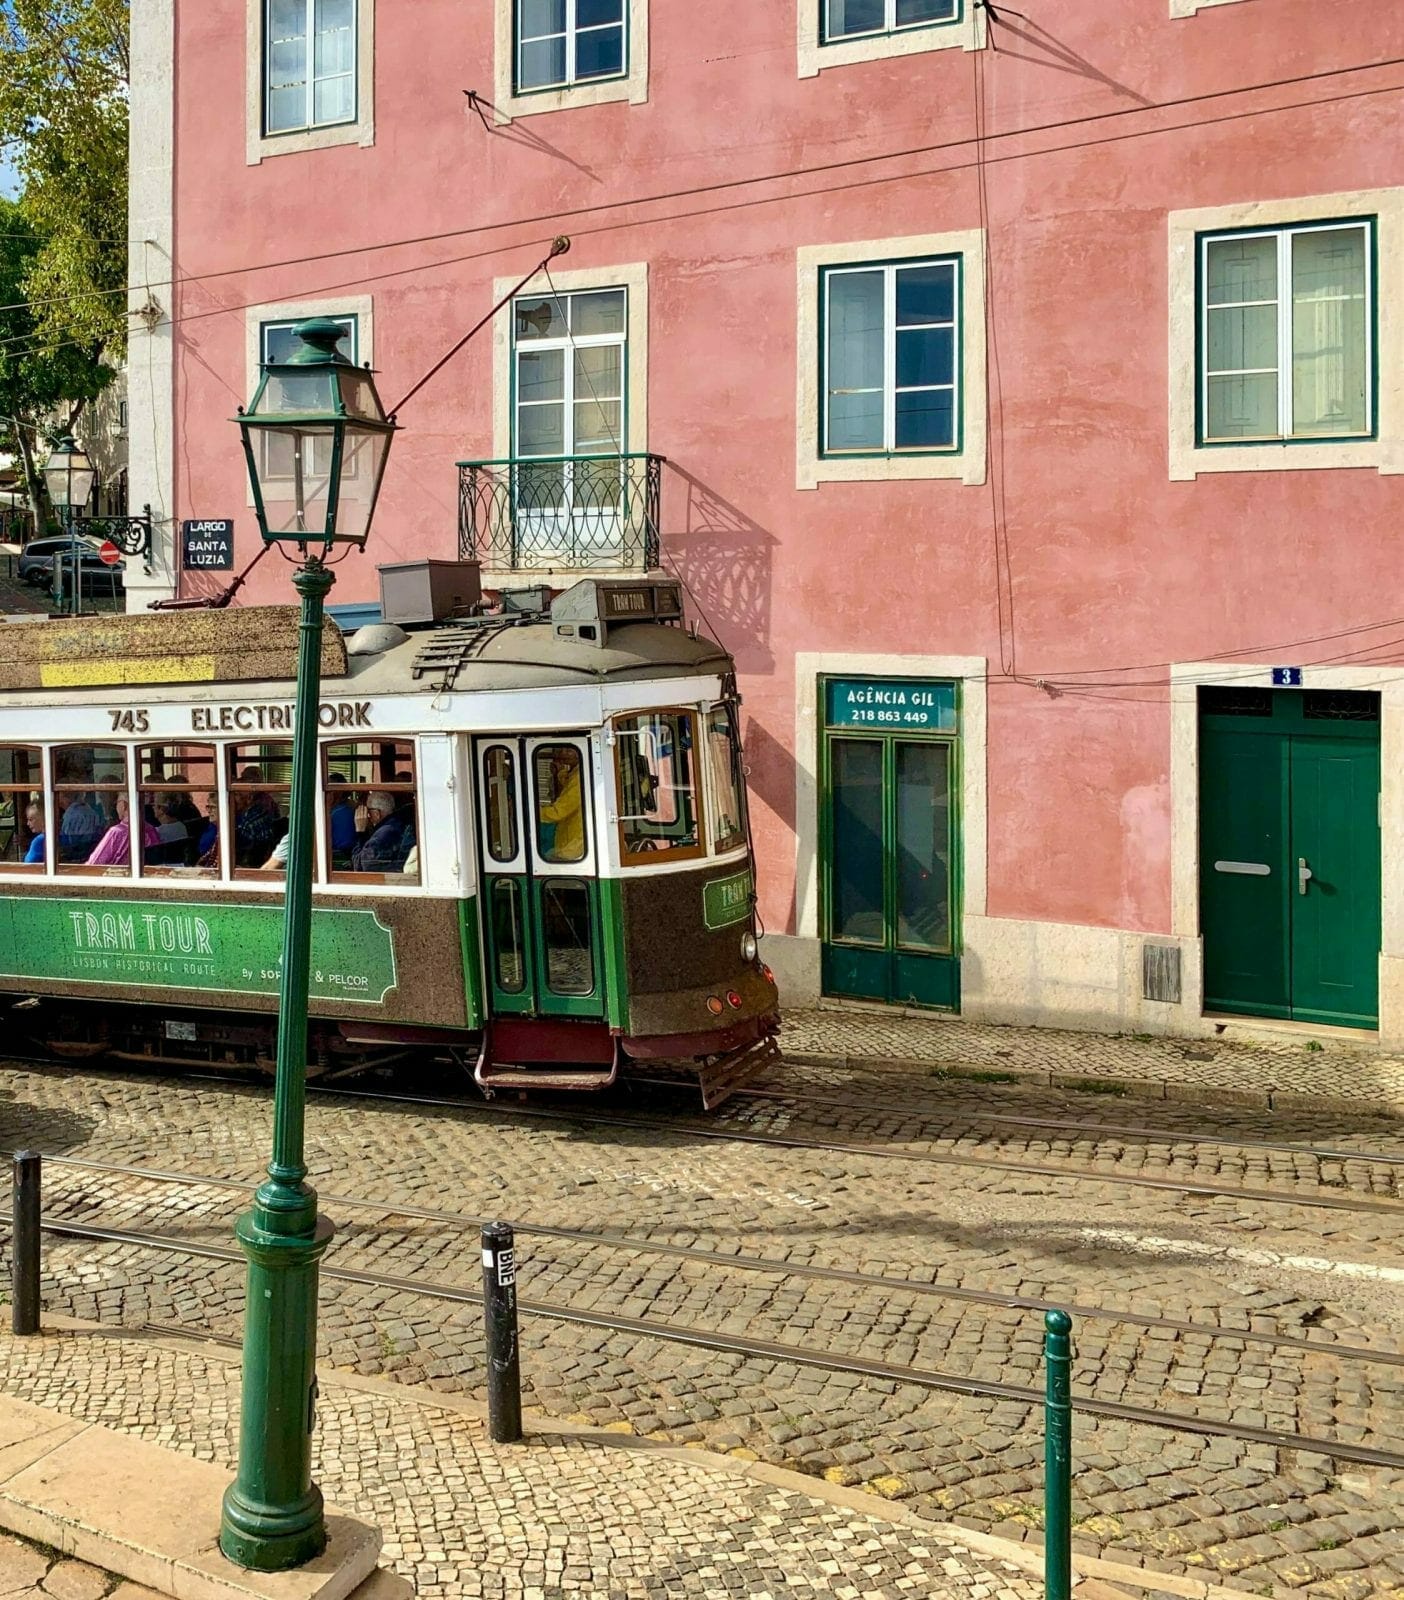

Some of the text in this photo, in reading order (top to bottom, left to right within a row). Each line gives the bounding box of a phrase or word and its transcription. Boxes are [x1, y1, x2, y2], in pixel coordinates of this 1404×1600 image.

[190, 521, 226, 531] LARGO
[188, 541, 227, 551] SANTA
[190, 554, 225, 565] LUZIA
[1282, 669, 1291, 684] 3
[847, 686, 935, 706] AGÊNCIA GIL
[108, 709, 149, 732] 745
[851, 709, 928, 723] 218 863 449
[69, 911, 213, 954] TRAM TOUR
[74, 957, 216, 976] LISBON HISTORICAL ROUTE
[242, 968, 253, 980] By
[315, 971, 324, 983] &
[329, 974, 369, 986] PELCOR
[500, 1252, 514, 1284] BNE
